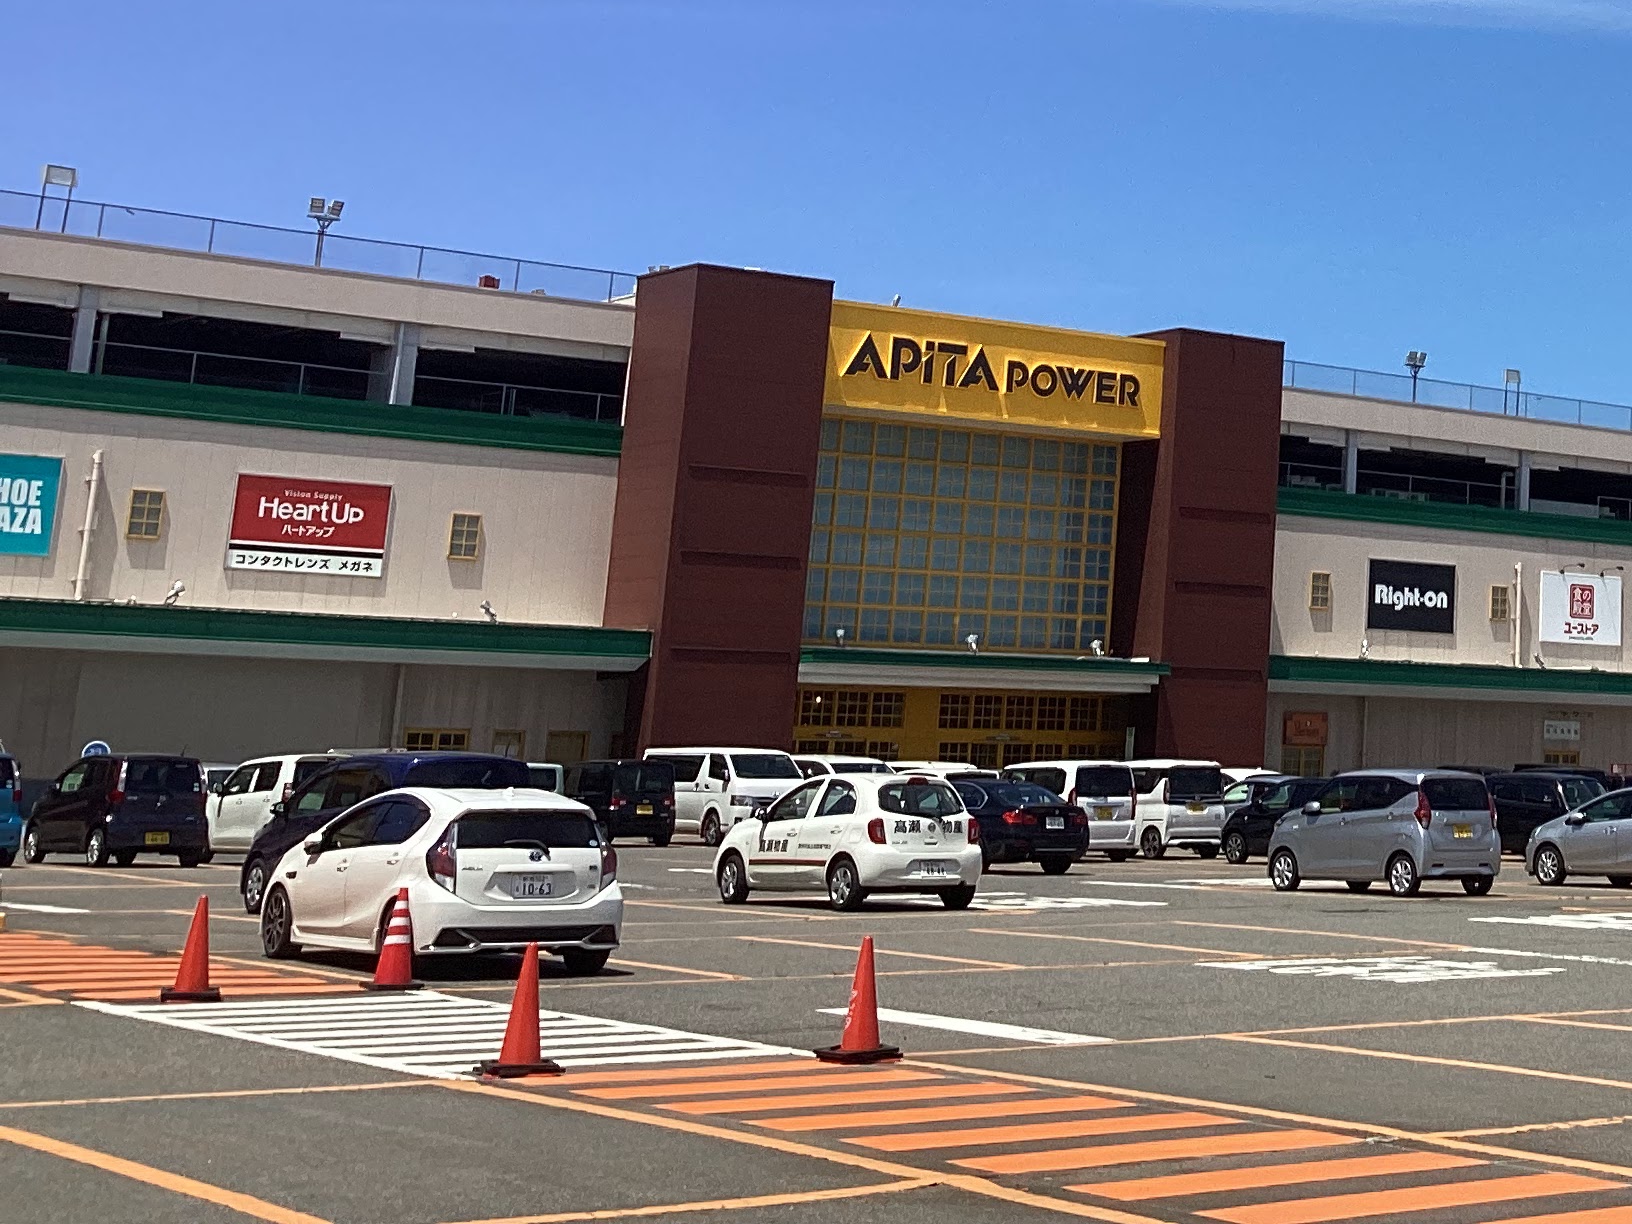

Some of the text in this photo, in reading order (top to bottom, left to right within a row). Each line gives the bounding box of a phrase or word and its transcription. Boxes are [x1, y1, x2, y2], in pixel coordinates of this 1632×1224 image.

[1003, 358, 1141, 408] POWER
[313, 490, 344, 502] Supply
[281, 524, 336, 538] ハートアップ
[235, 554, 374, 573] コンタクトレンズ メガネ
[1374, 583, 1448, 611] Right-on
[1563, 621, 1599, 636] ユーストア
